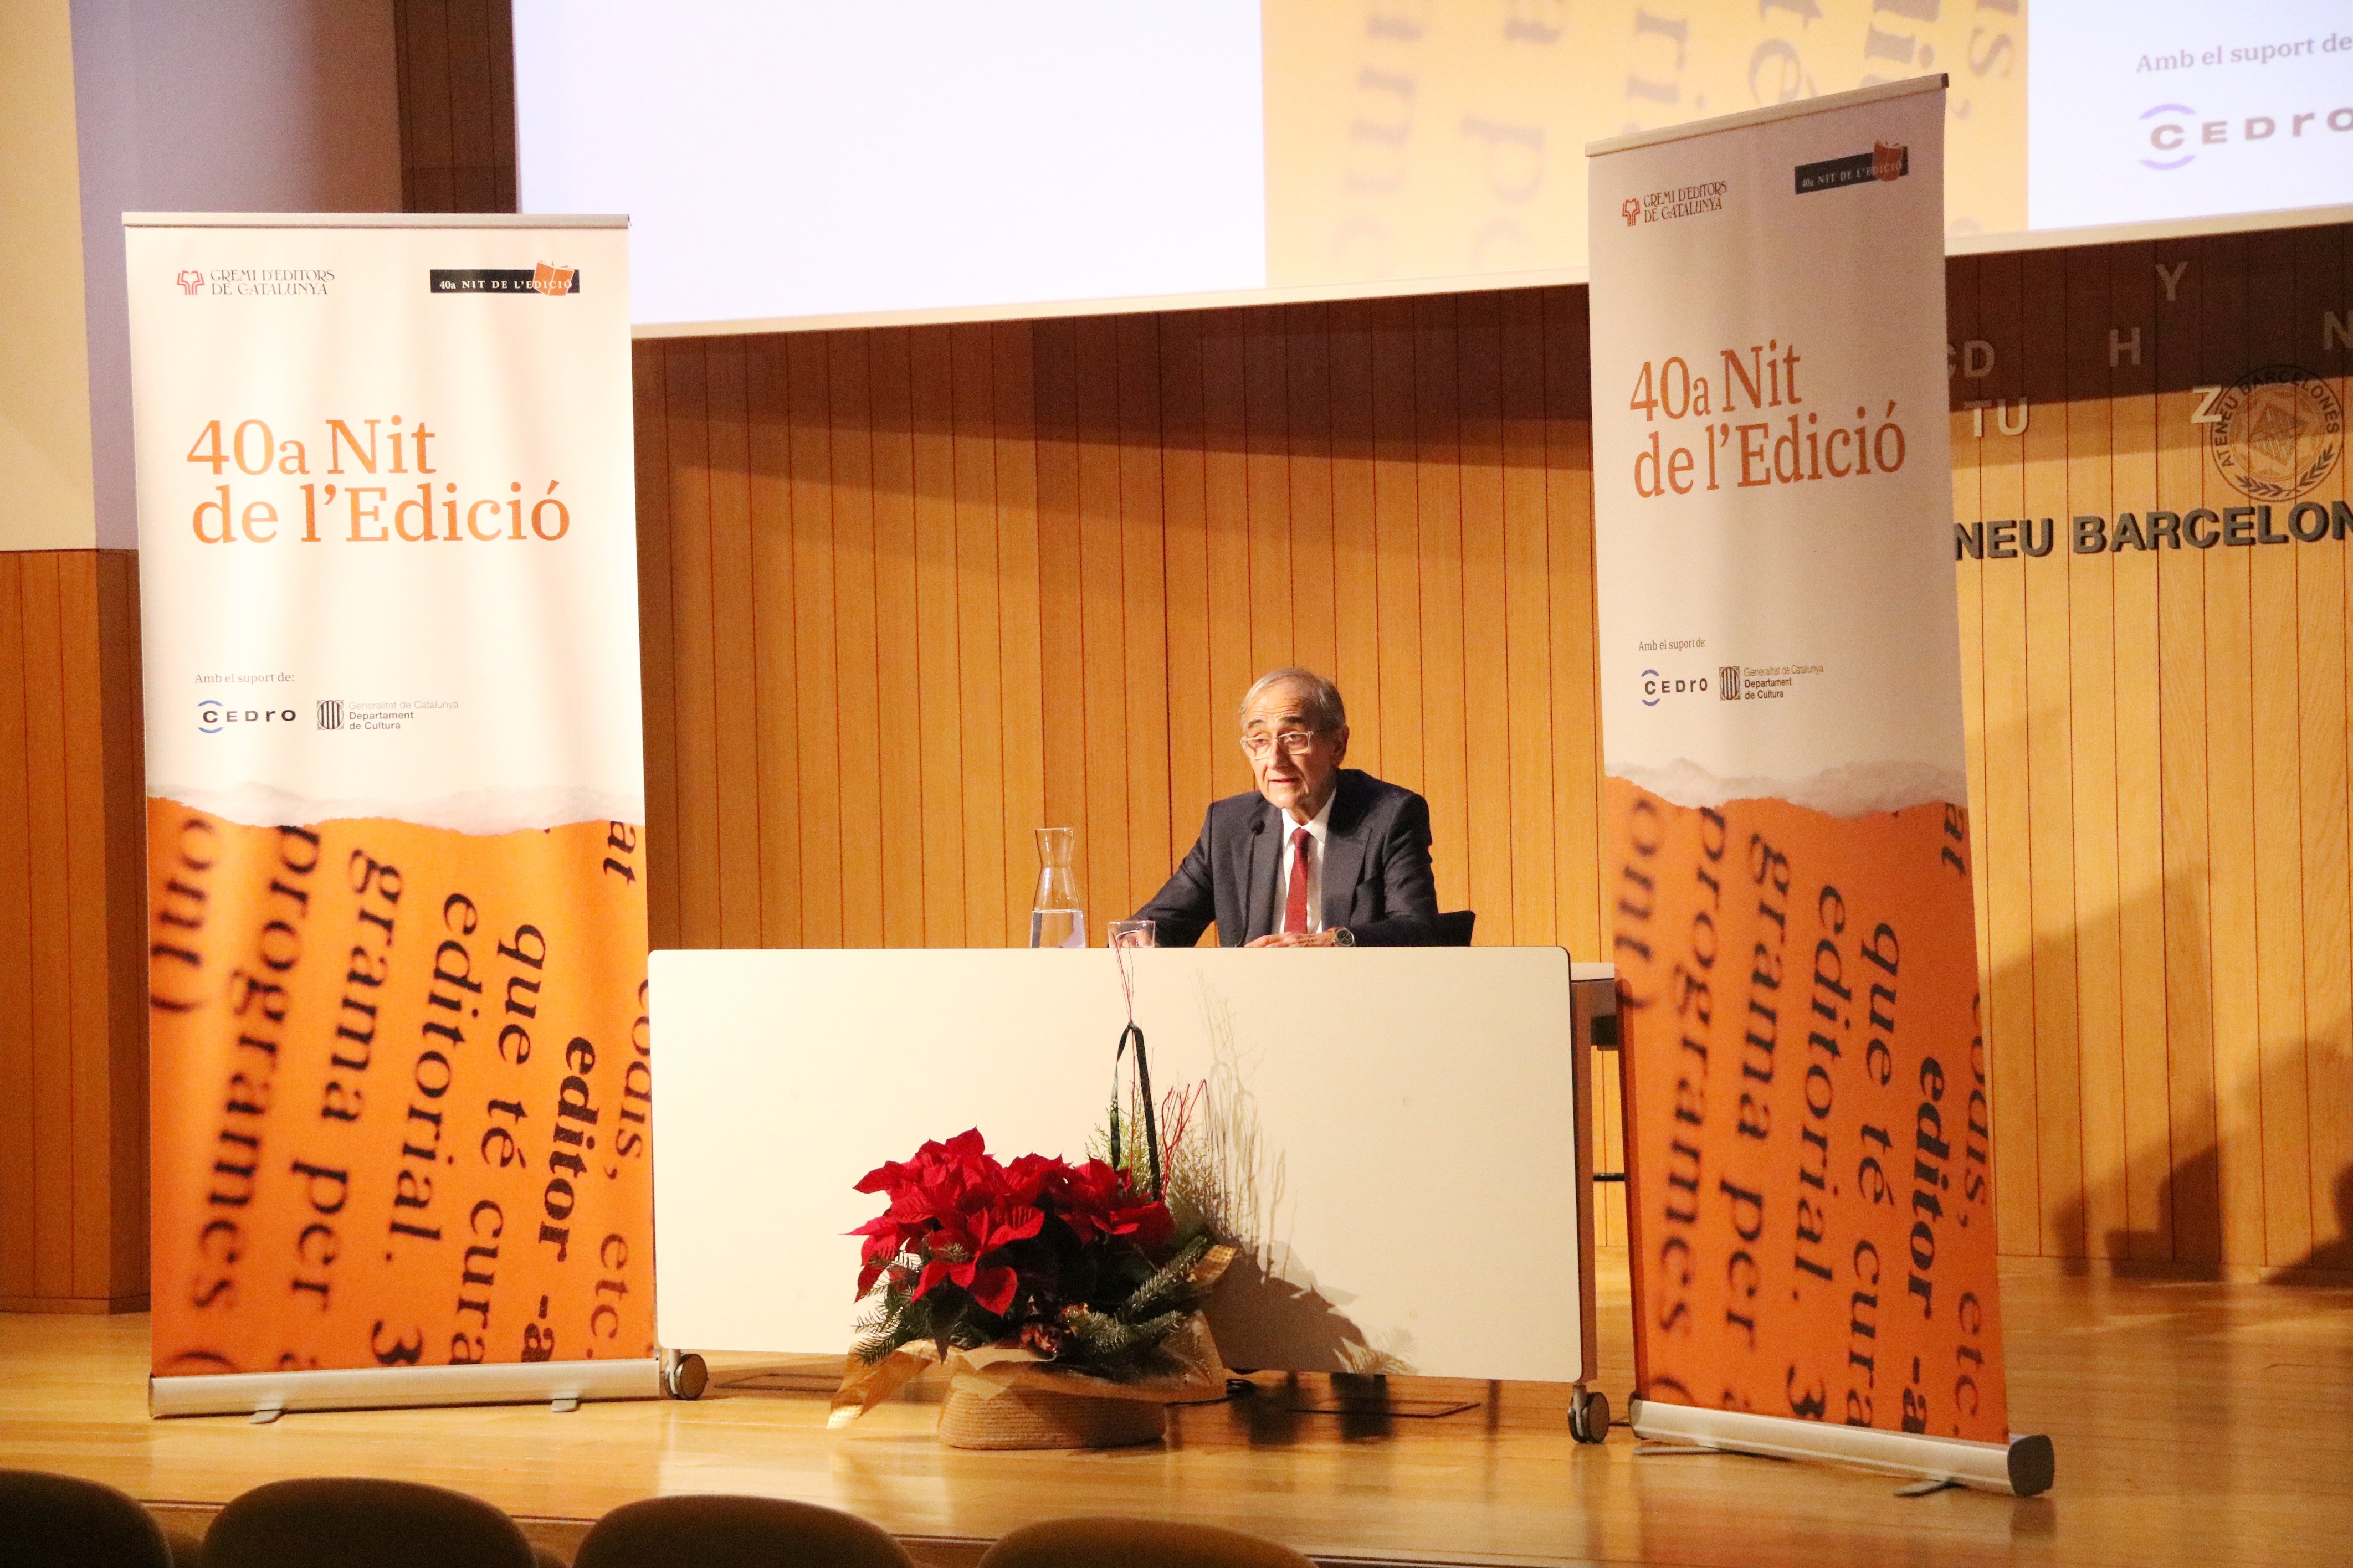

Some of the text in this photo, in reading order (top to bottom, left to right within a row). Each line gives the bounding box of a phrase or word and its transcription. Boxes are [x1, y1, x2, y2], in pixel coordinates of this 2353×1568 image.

[2136, 49, 2194, 73] Amb
[2202, 45, 2223, 65] el
[2230, 39, 2314, 64] suport
[1644, 181, 1727, 208] GREMI D'EDITORS
[1818, 173, 1835, 185] NIT
[1840, 171, 1852, 181] DE
[1644, 197, 1722, 223] DE CATALUNYA
[211, 269, 335, 282] GREMI D'EDITORS
[212, 283, 327, 295] DE CATALUNYA
[439, 281, 456, 289] 40a
[2155, 261, 2188, 301] Y
[2109, 328, 2141, 367] H
[1630, 339, 1802, 421] 40a Nit
[2191, 385, 2223, 424] Z
[187, 415, 437, 475] 40a Nit
[1634, 399, 1905, 498] de l'Edició
[193, 480, 570, 544] de l'Edició
[1639, 638, 1706, 651] Amb el suport de:
[195, 672, 295, 685] Amb el suport de:
[1744, 665, 1824, 677] Generalitat de Catalunya
[1744, 677, 1791, 688] Departament
[349, 700, 459, 711] Generalitat de Catalunya
[1745, 690, 1783, 700] de Cultura
[349, 721, 401, 730] de Cultura
[350, 711, 414, 722] Departament
[321, 848, 404, 1123] grama
[1736, 831, 1792, 1143] grama
[382, 892, 485, 1265] editorial.
[1793, 884, 1853, 1302] editorial.
[448, 924, 546, 1366] que té cura
[539, 1036, 600, 1262] editor
[1846, 922, 1900, 1428] que té cura
[1908, 1057, 1950, 1320] editor
[290, 1157, 350, 1311] per
[1719, 1172, 1764, 1350] per
